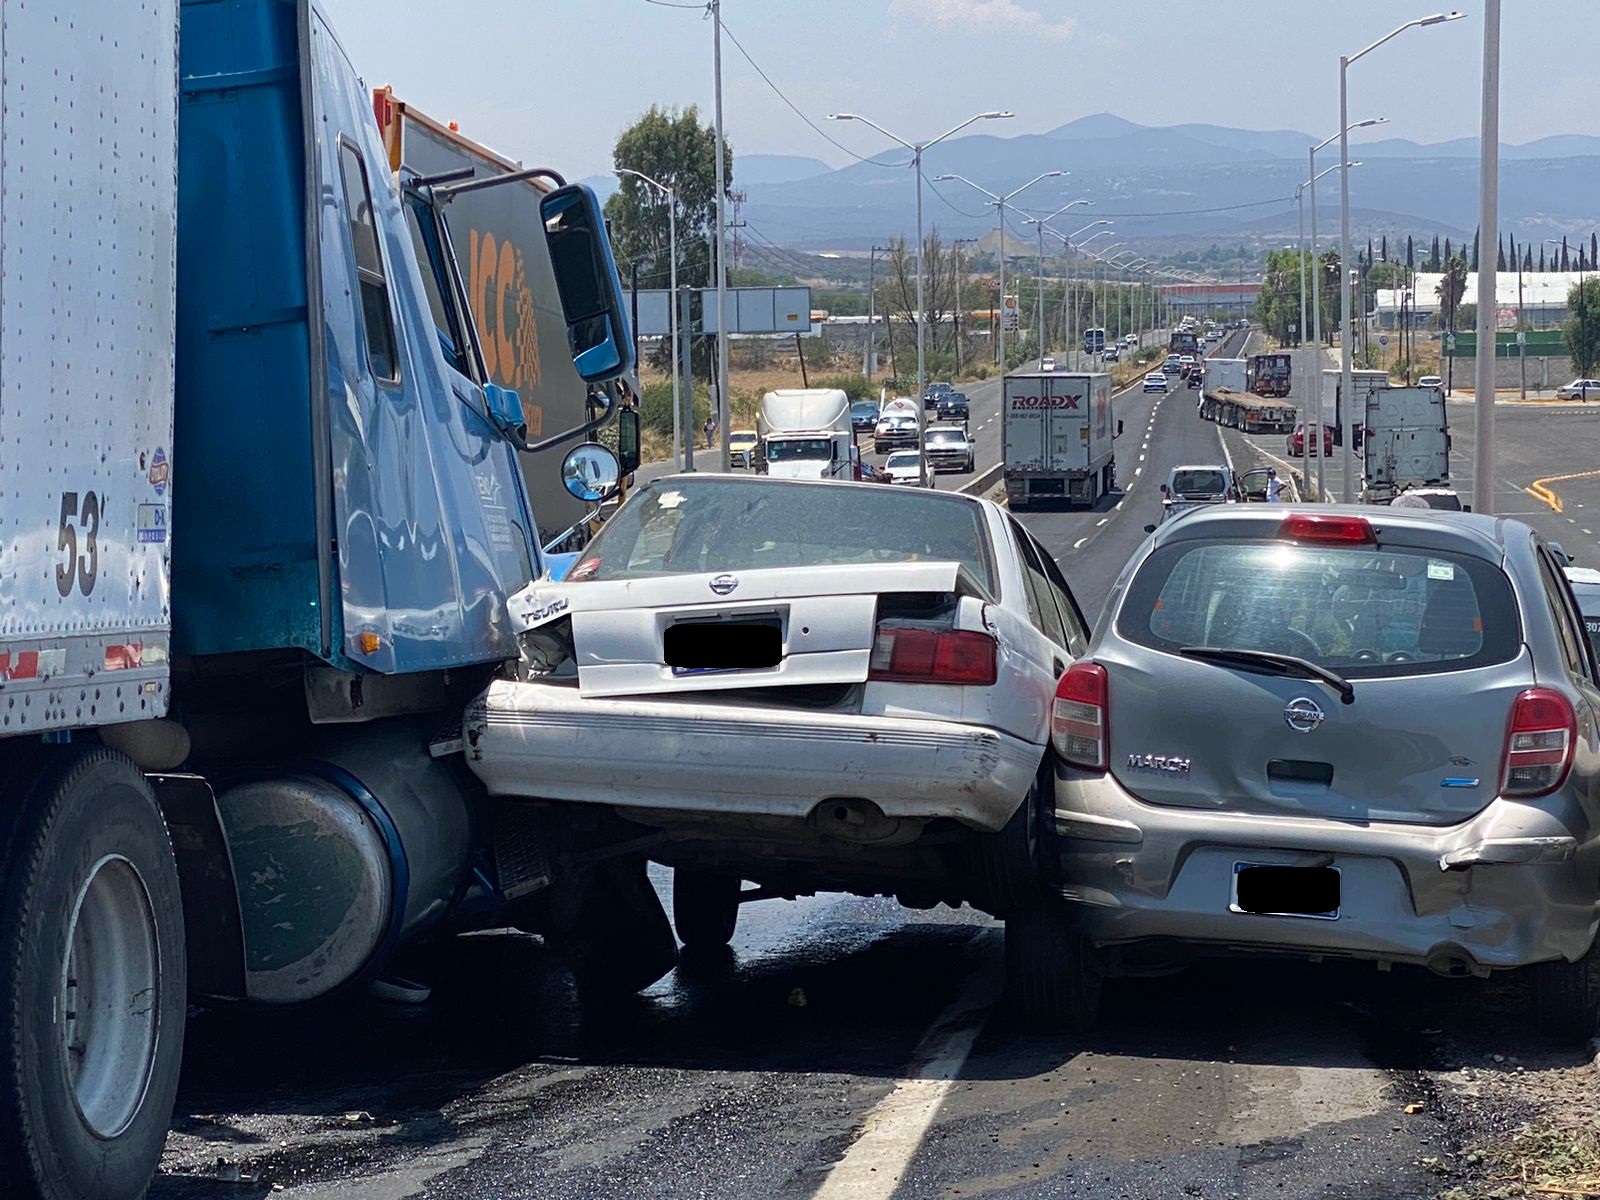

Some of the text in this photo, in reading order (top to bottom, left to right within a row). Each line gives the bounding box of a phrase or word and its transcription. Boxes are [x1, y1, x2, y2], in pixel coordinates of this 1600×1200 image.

[1011, 395, 1083, 410] ROADX
[521, 597, 569, 625] TSURU
[1128, 754, 1190, 772] MARCH
